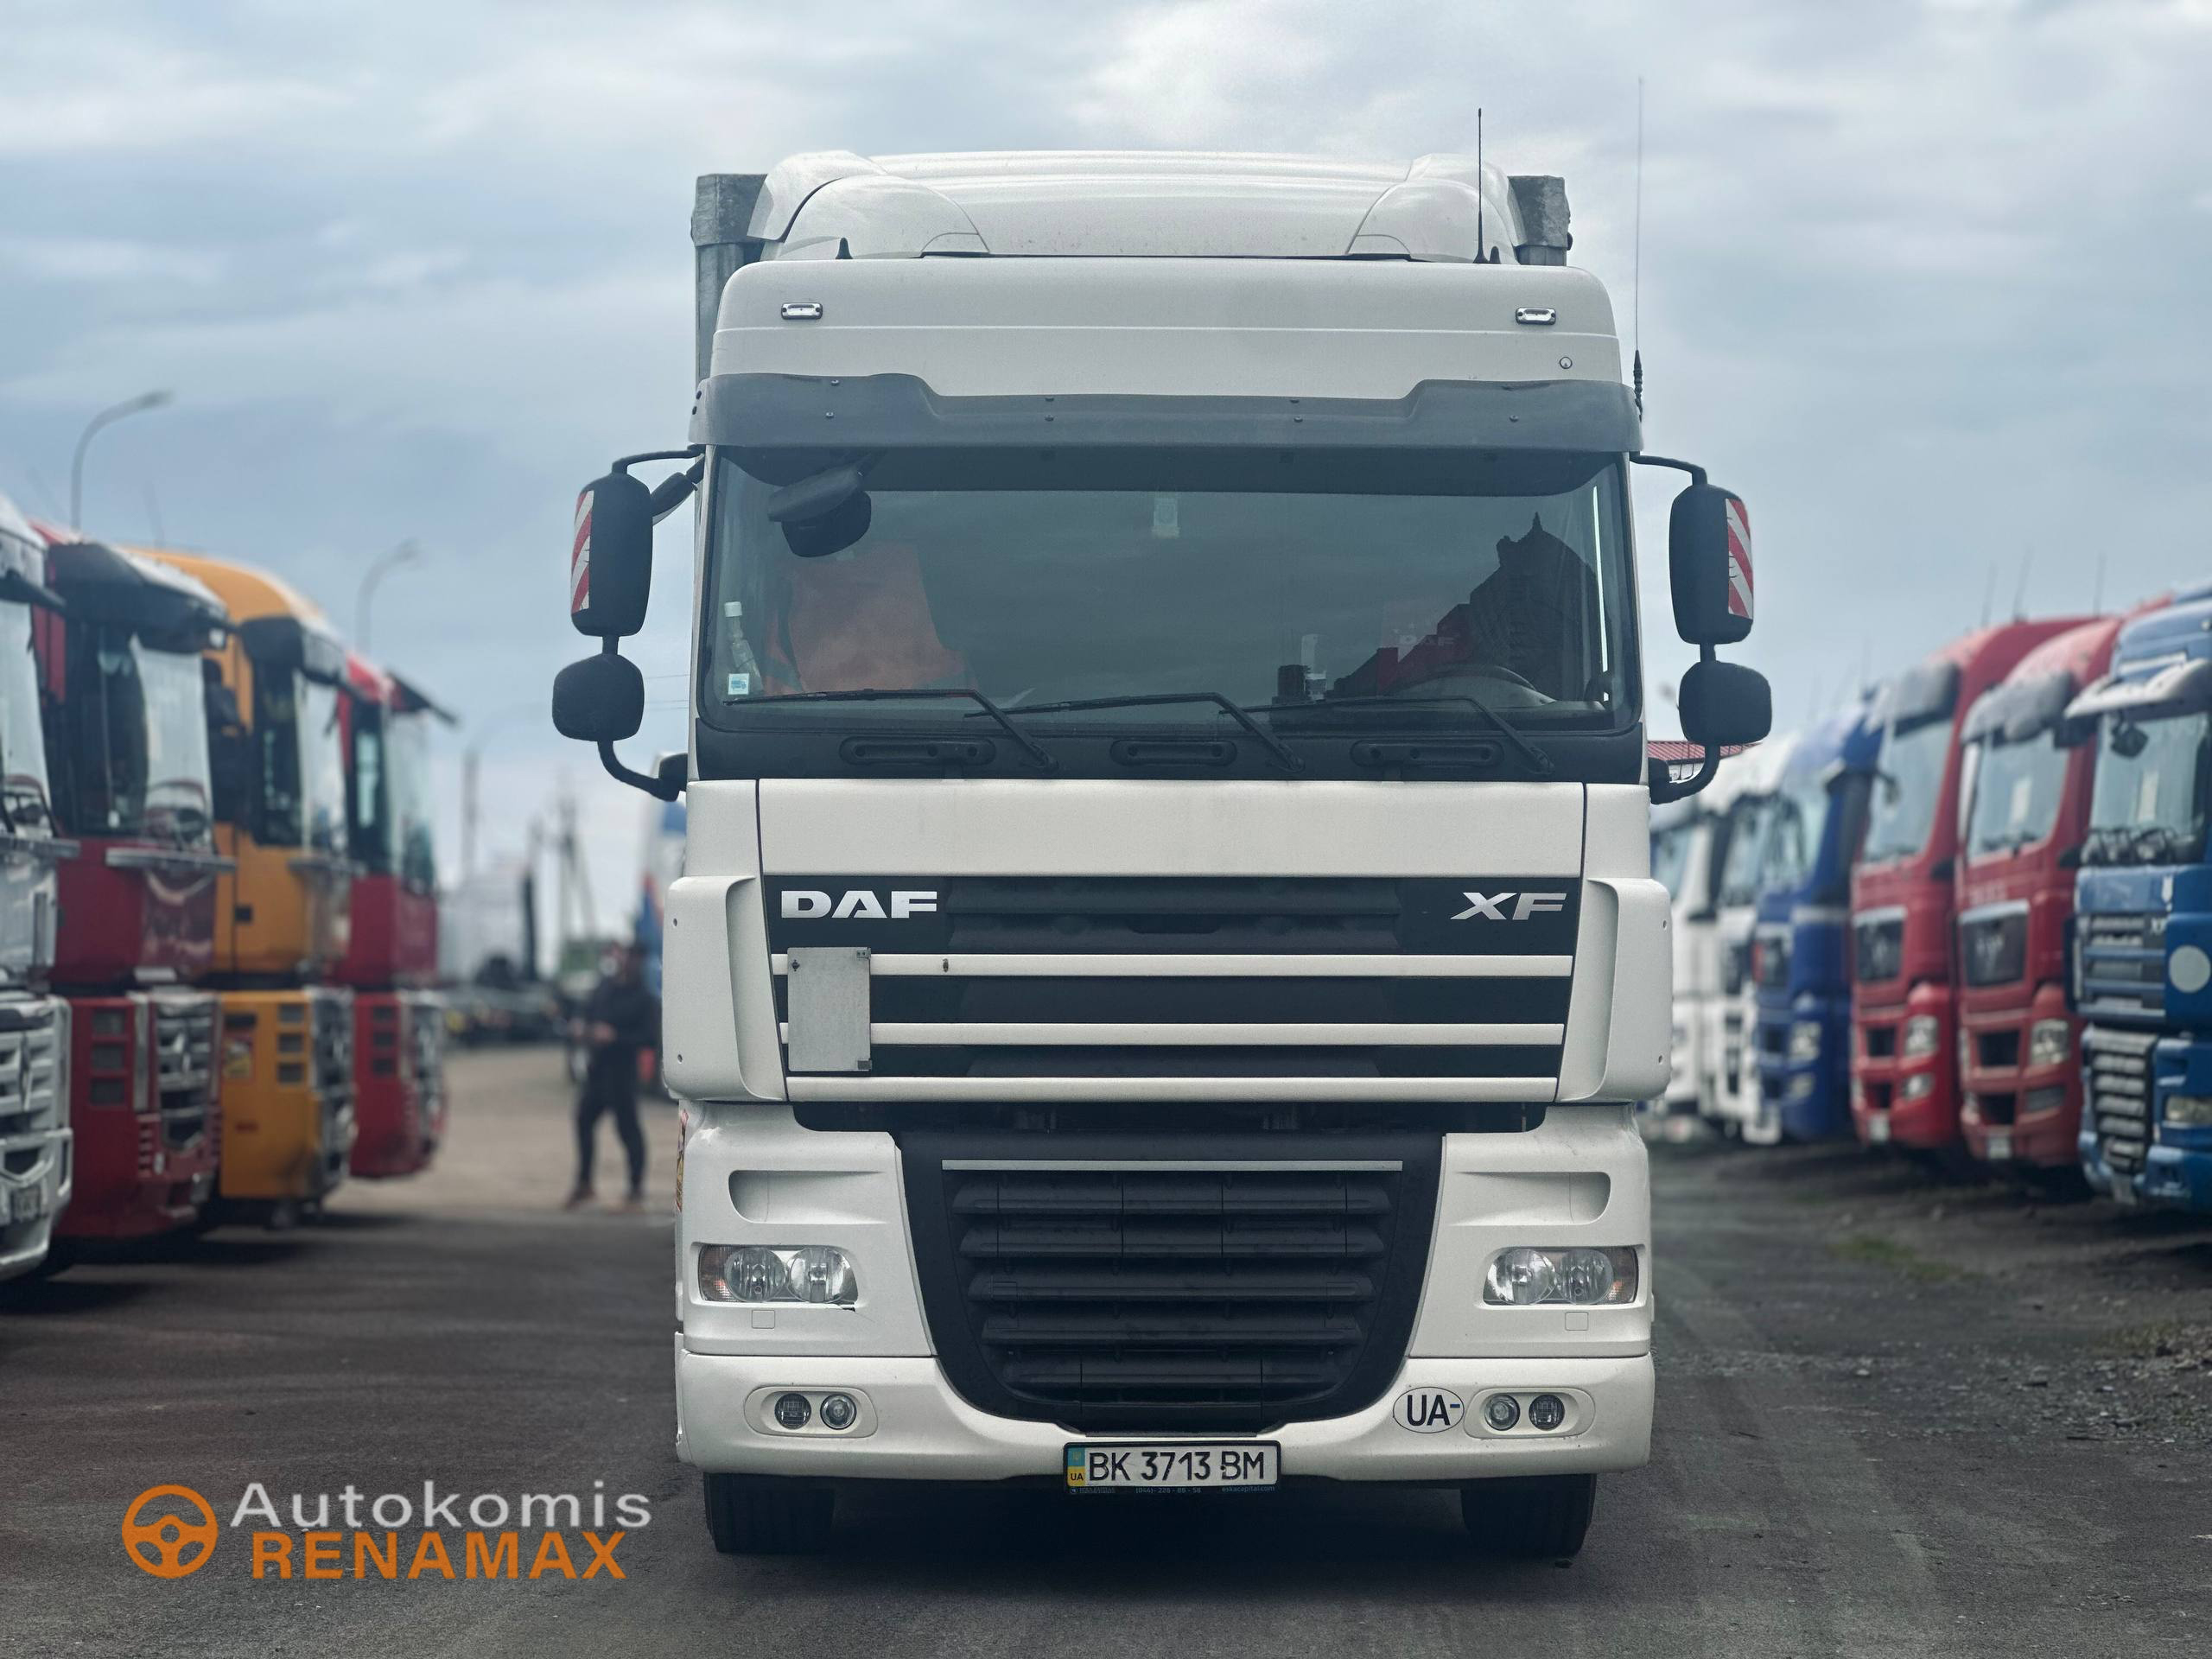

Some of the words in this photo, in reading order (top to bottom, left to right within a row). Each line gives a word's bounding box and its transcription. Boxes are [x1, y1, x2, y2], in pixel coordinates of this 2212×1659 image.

[781, 890, 938, 918] DAF
[1450, 892, 1567, 920] XF
[1407, 1394, 1451, 1427] UA
[1070, 1472, 1084, 1481] UA
[1089, 1452, 1131, 1481] BK
[1141, 1451, 1211, 1481] 3713
[1220, 1450, 1264, 1480] BM
